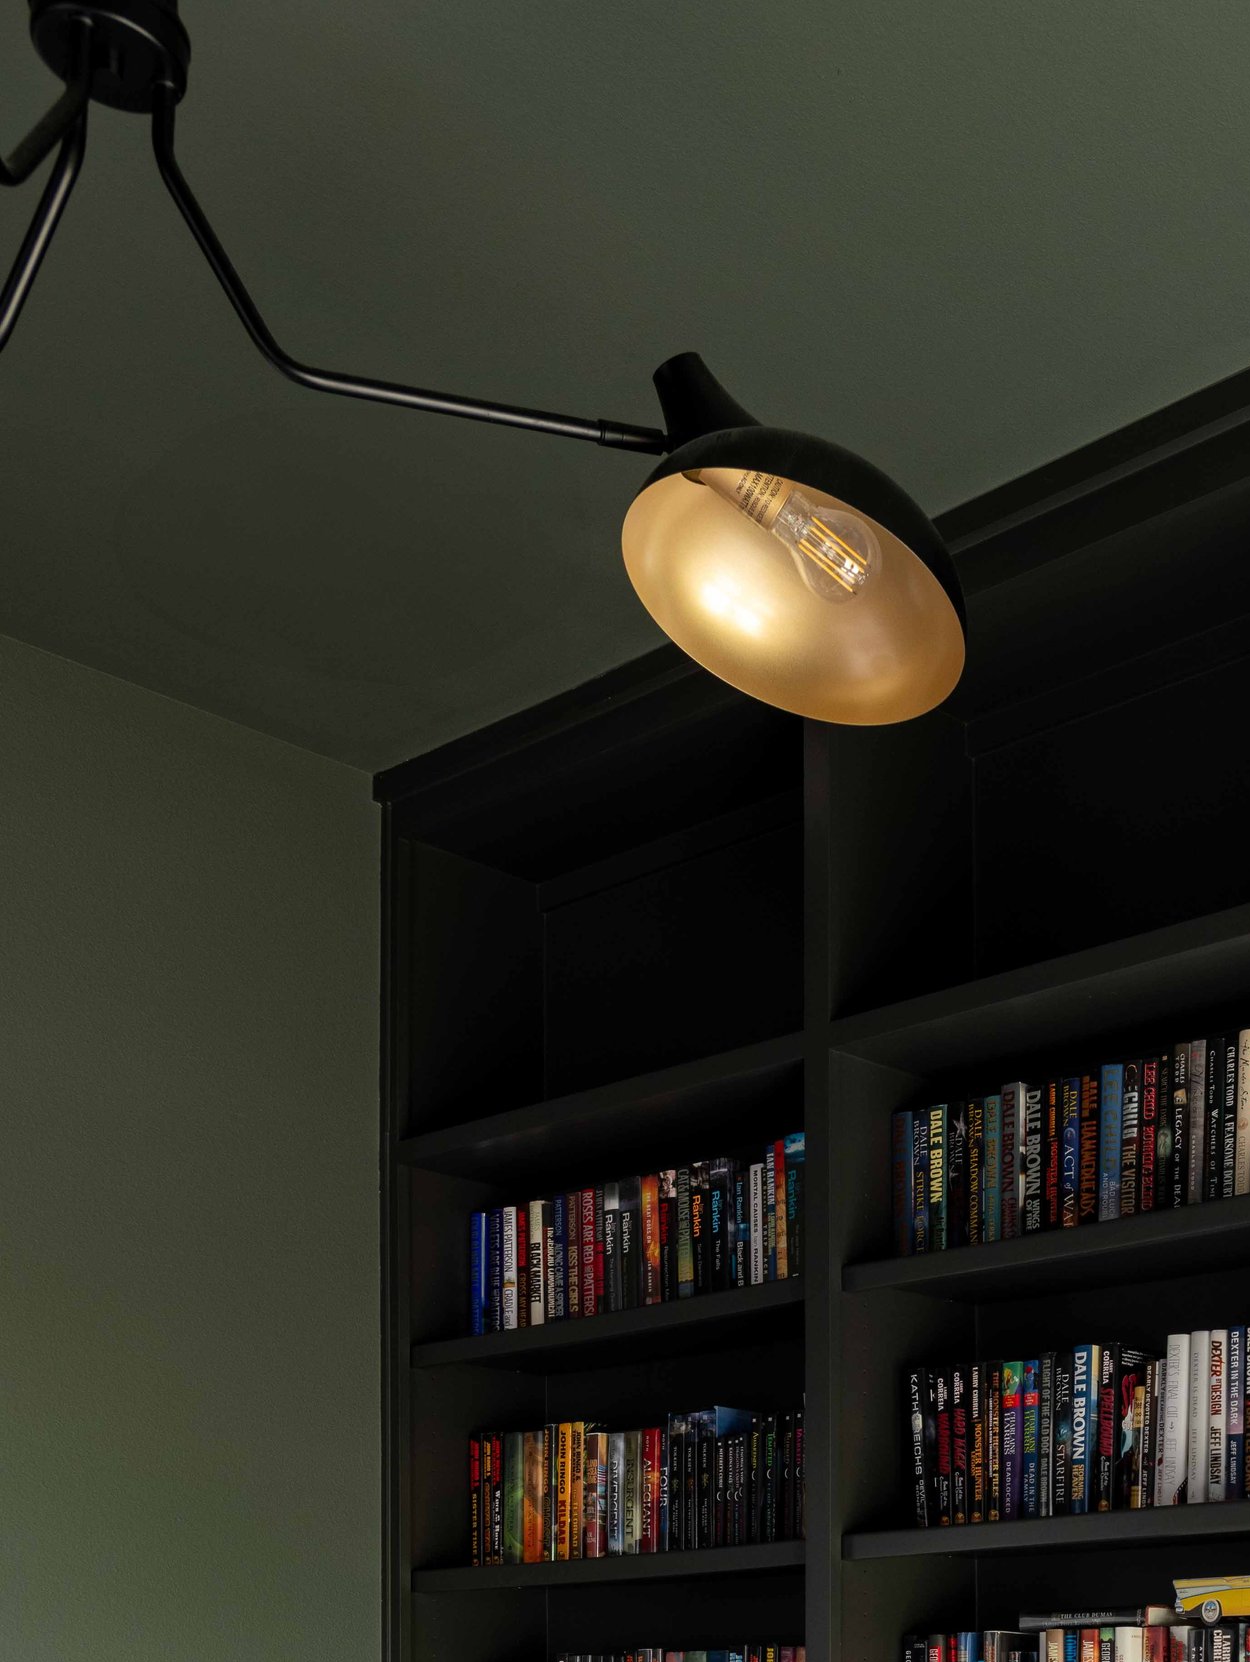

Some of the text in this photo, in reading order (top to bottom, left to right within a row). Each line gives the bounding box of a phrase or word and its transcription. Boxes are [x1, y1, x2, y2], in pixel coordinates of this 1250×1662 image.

[930, 1111, 942, 1203] DALE BROWN
[1026, 1091, 1040, 1196] DALE BROWN
[1211, 1341, 1222, 1377] DEXTER
[1073, 1352, 1087, 1459] DALE BROWN
[1211, 1385, 1222, 1416] DESIGN
[610, 1461, 619, 1539] DIVERGENT
[625, 1459, 634, 1537] INSURGENT
